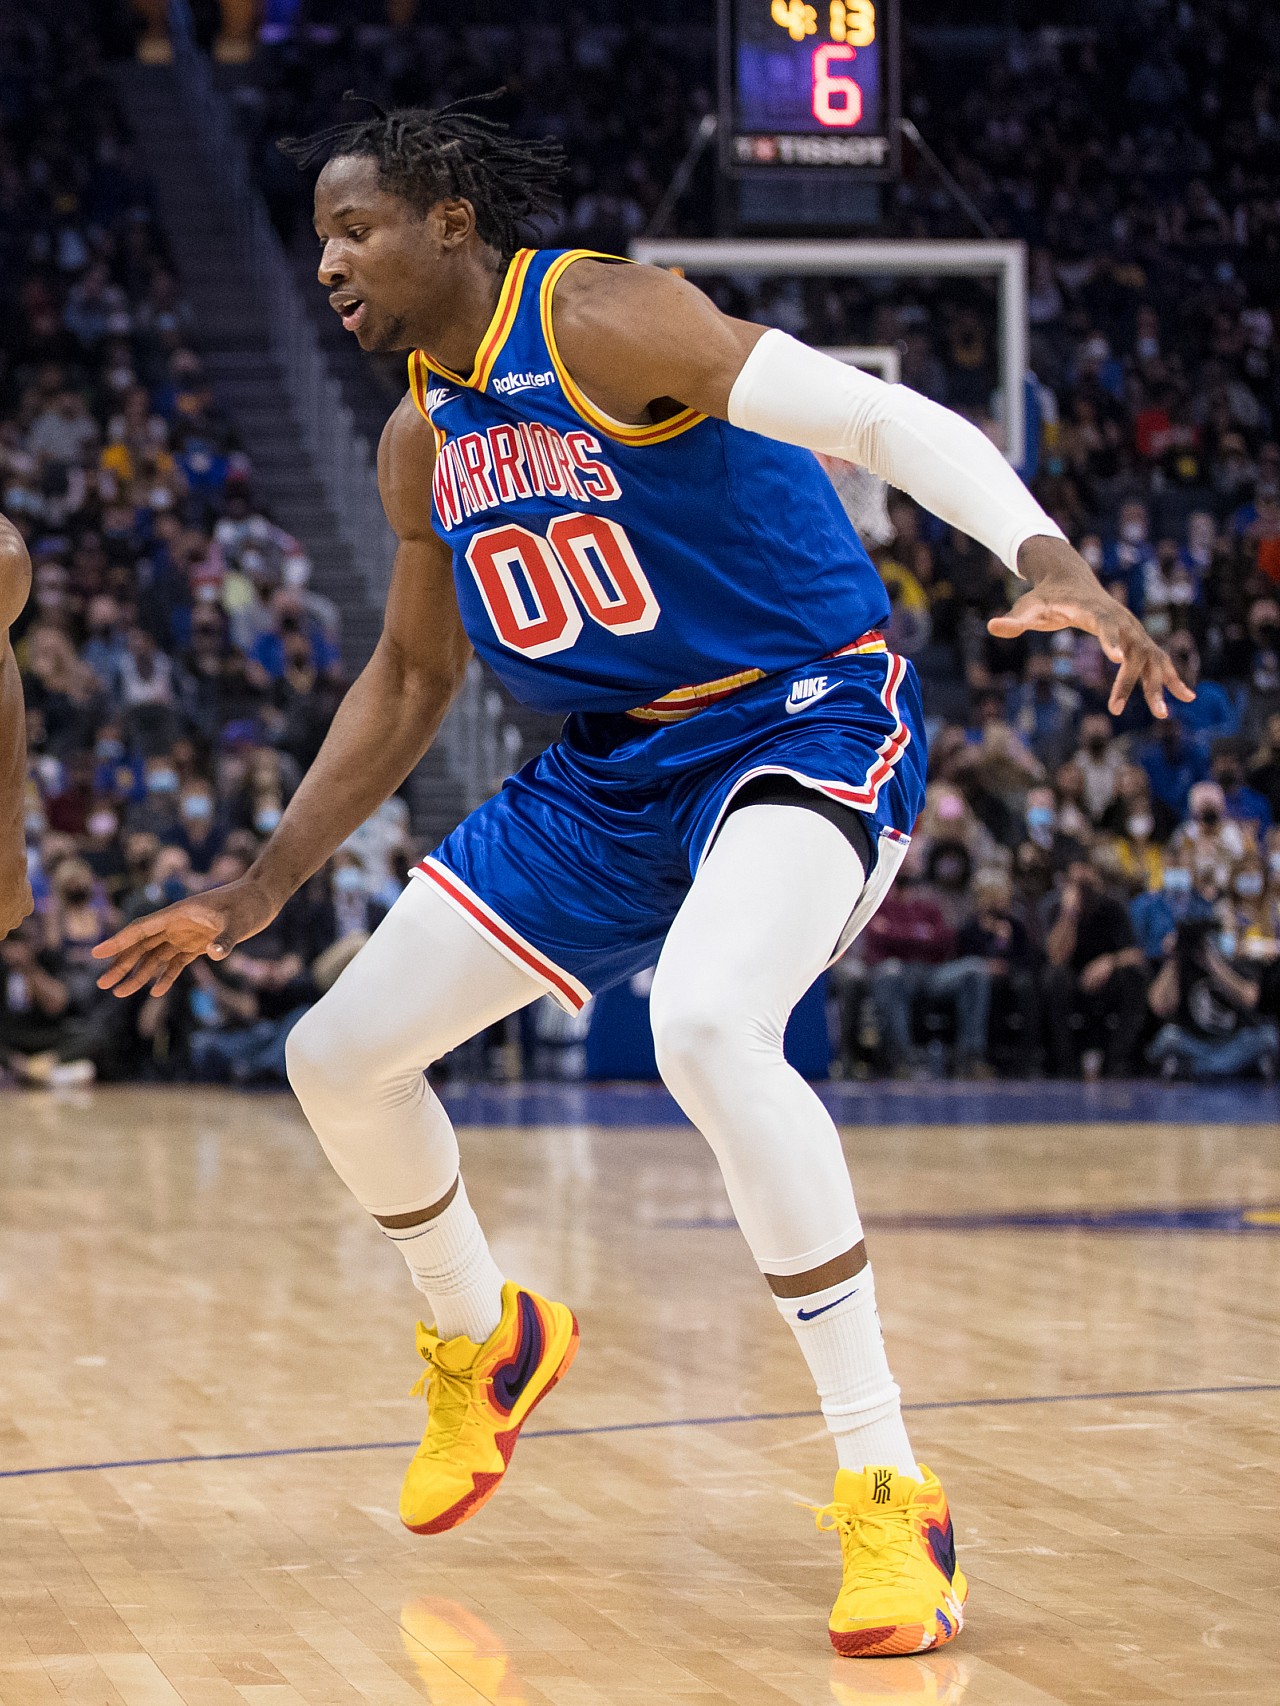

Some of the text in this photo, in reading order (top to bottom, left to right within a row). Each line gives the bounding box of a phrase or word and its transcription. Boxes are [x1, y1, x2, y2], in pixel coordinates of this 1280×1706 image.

[771, 0, 875, 46] 4:13
[812, 42, 862, 126] 6
[492, 371, 555, 394] Rakuten
[433, 422, 622, 531] WARRIORS
[465, 512, 661, 660] 00
[791, 676, 828, 701] NIKE
